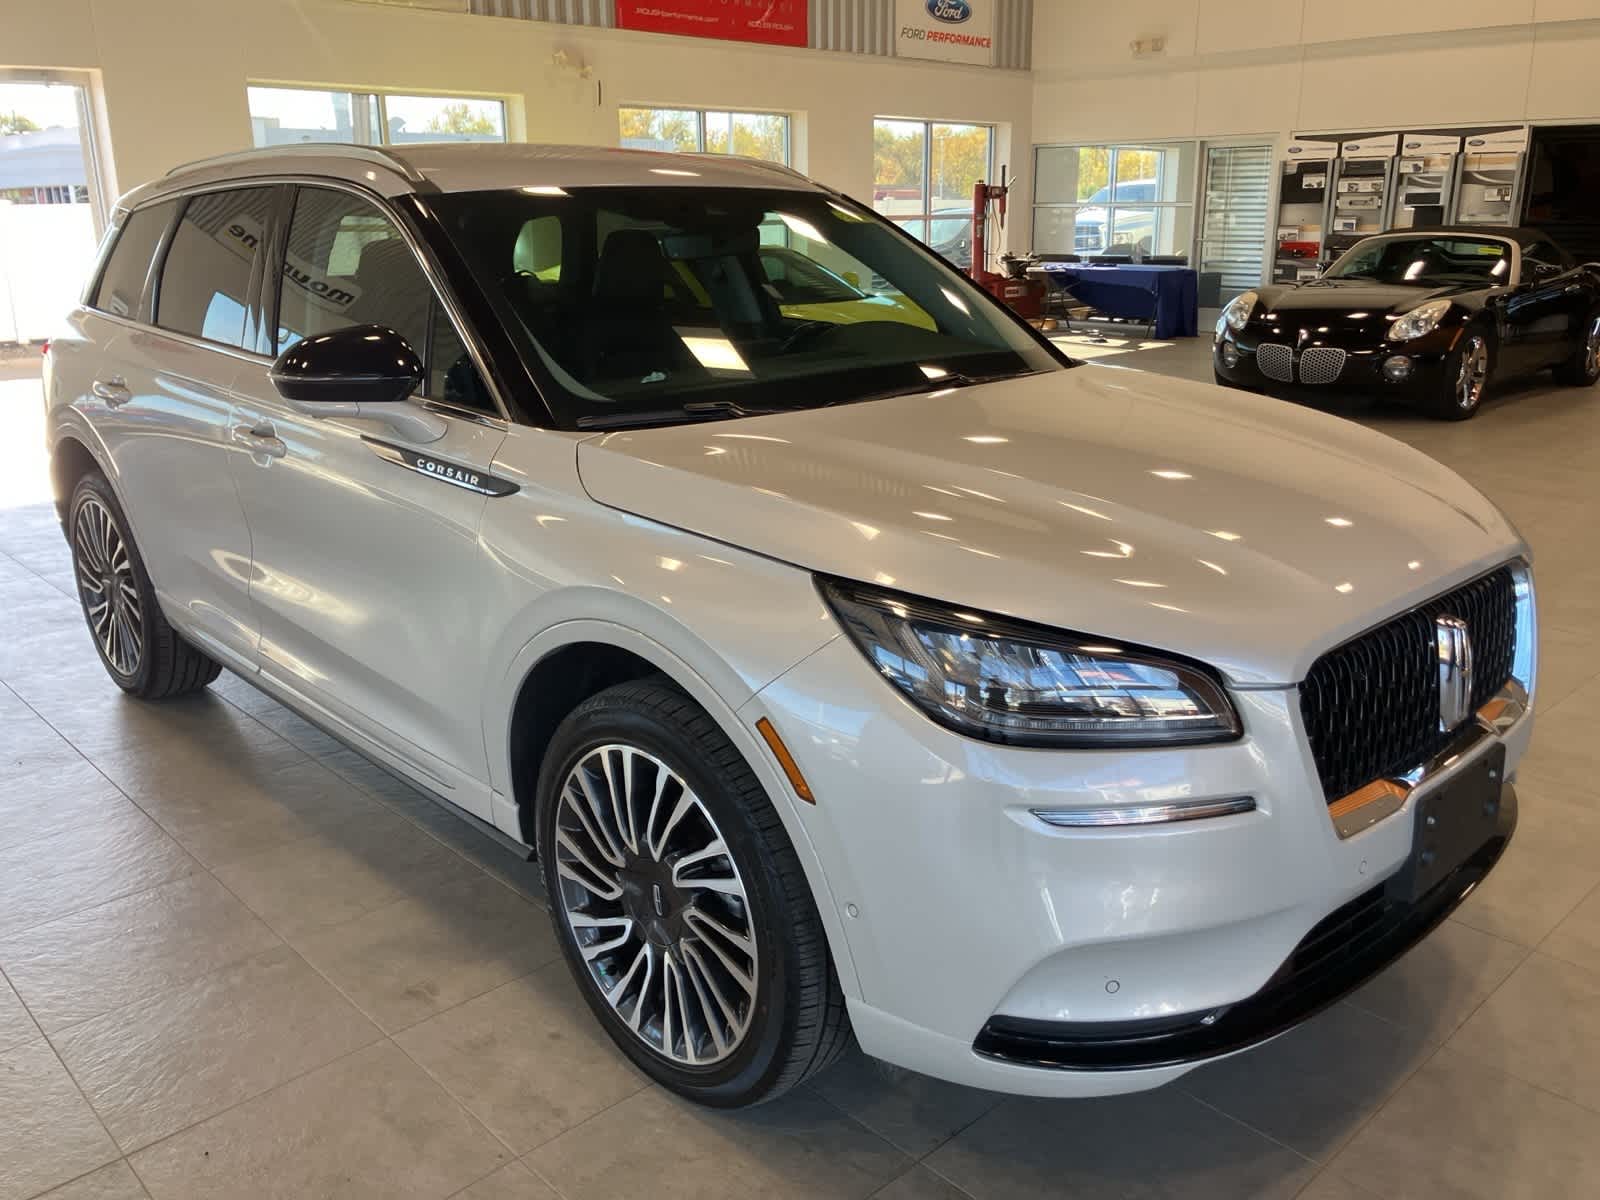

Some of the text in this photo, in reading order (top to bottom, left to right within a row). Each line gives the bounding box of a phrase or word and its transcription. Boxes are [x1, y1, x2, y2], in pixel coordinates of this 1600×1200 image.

[934, 0, 964, 19] Ford
[901, 27, 992, 48] FORD PERFORMANCE
[416, 458, 480, 486] CORSAIR
